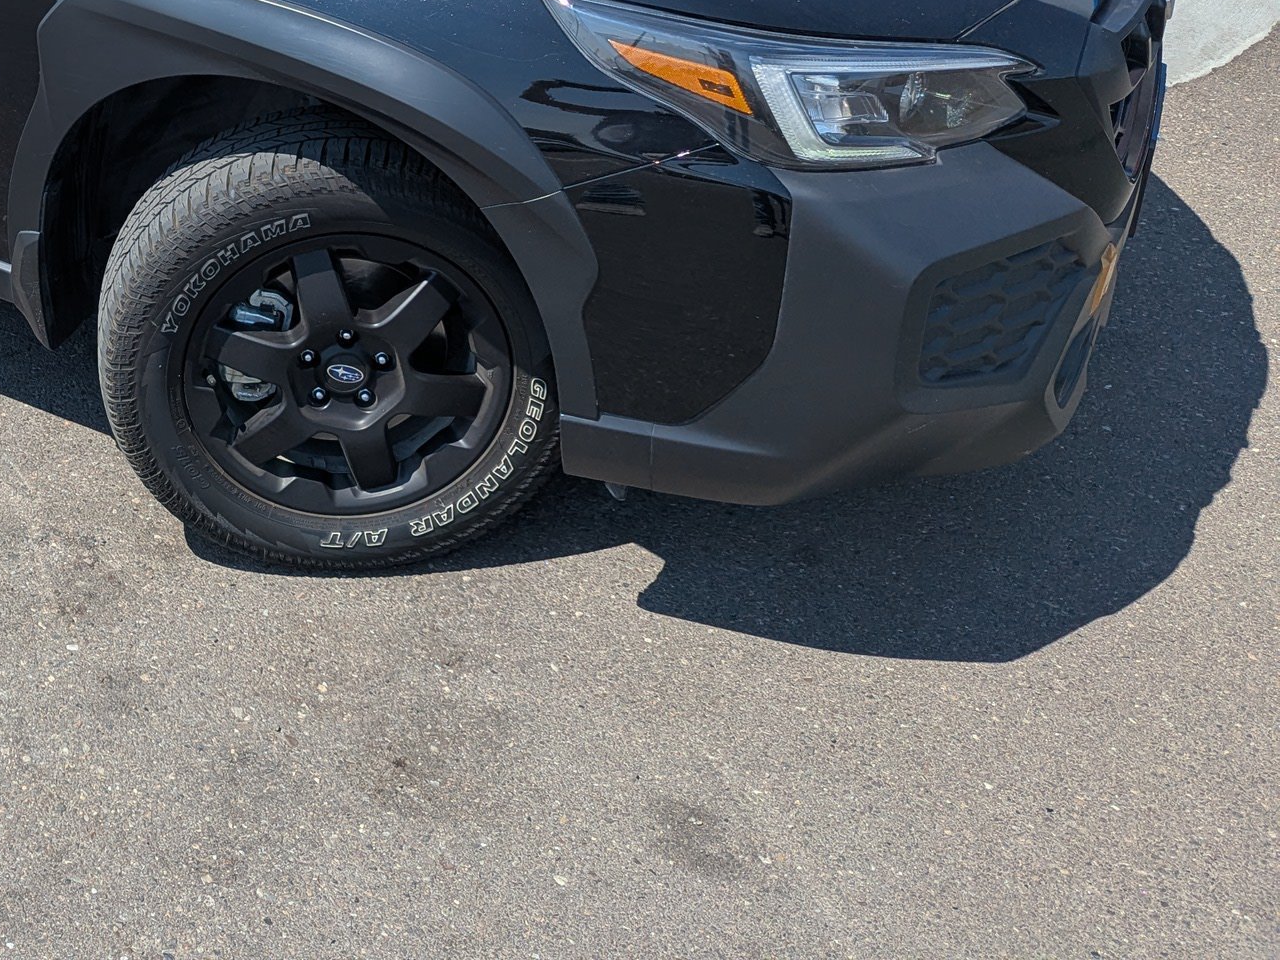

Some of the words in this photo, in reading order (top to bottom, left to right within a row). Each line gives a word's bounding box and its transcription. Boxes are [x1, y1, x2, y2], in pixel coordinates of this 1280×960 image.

[160, 213, 311, 333] YOKOHAMA
[409, 377, 547, 536] GEOLANDAR
[320, 528, 388, 548] A/T
